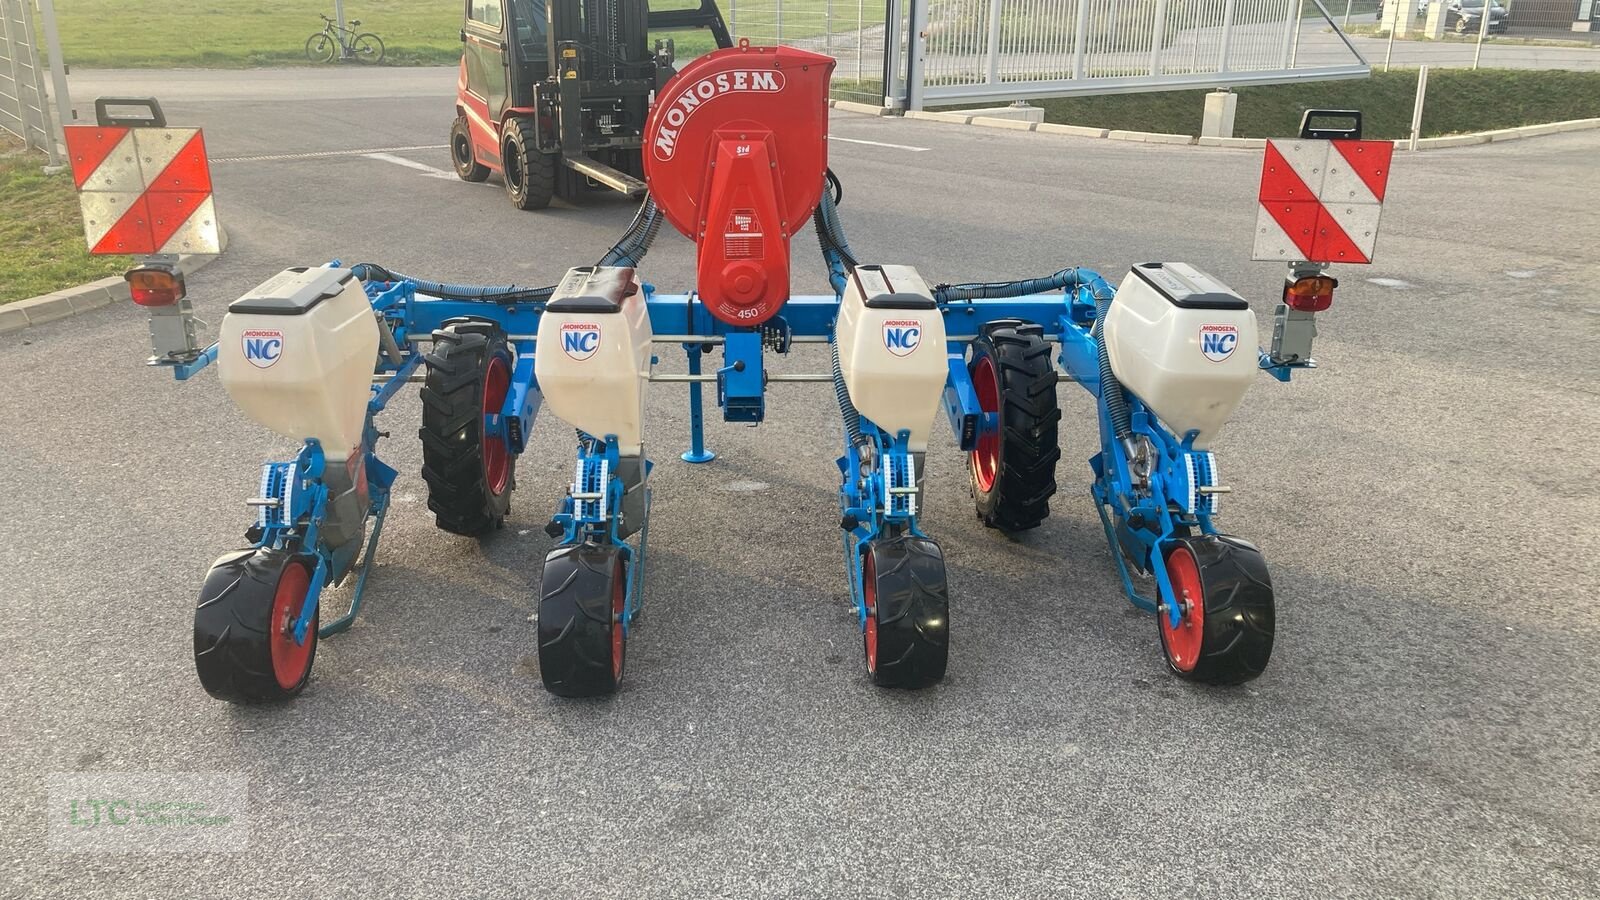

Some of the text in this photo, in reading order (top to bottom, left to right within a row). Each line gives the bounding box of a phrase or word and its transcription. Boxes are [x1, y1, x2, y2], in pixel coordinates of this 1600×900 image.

[656, 72, 778, 156] MONOSEM
[737, 308, 759, 319] 450
[565, 332, 598, 352] NC
[887, 328, 919, 348] NC
[1204, 333, 1236, 354] NC
[247, 339, 280, 360] NC
